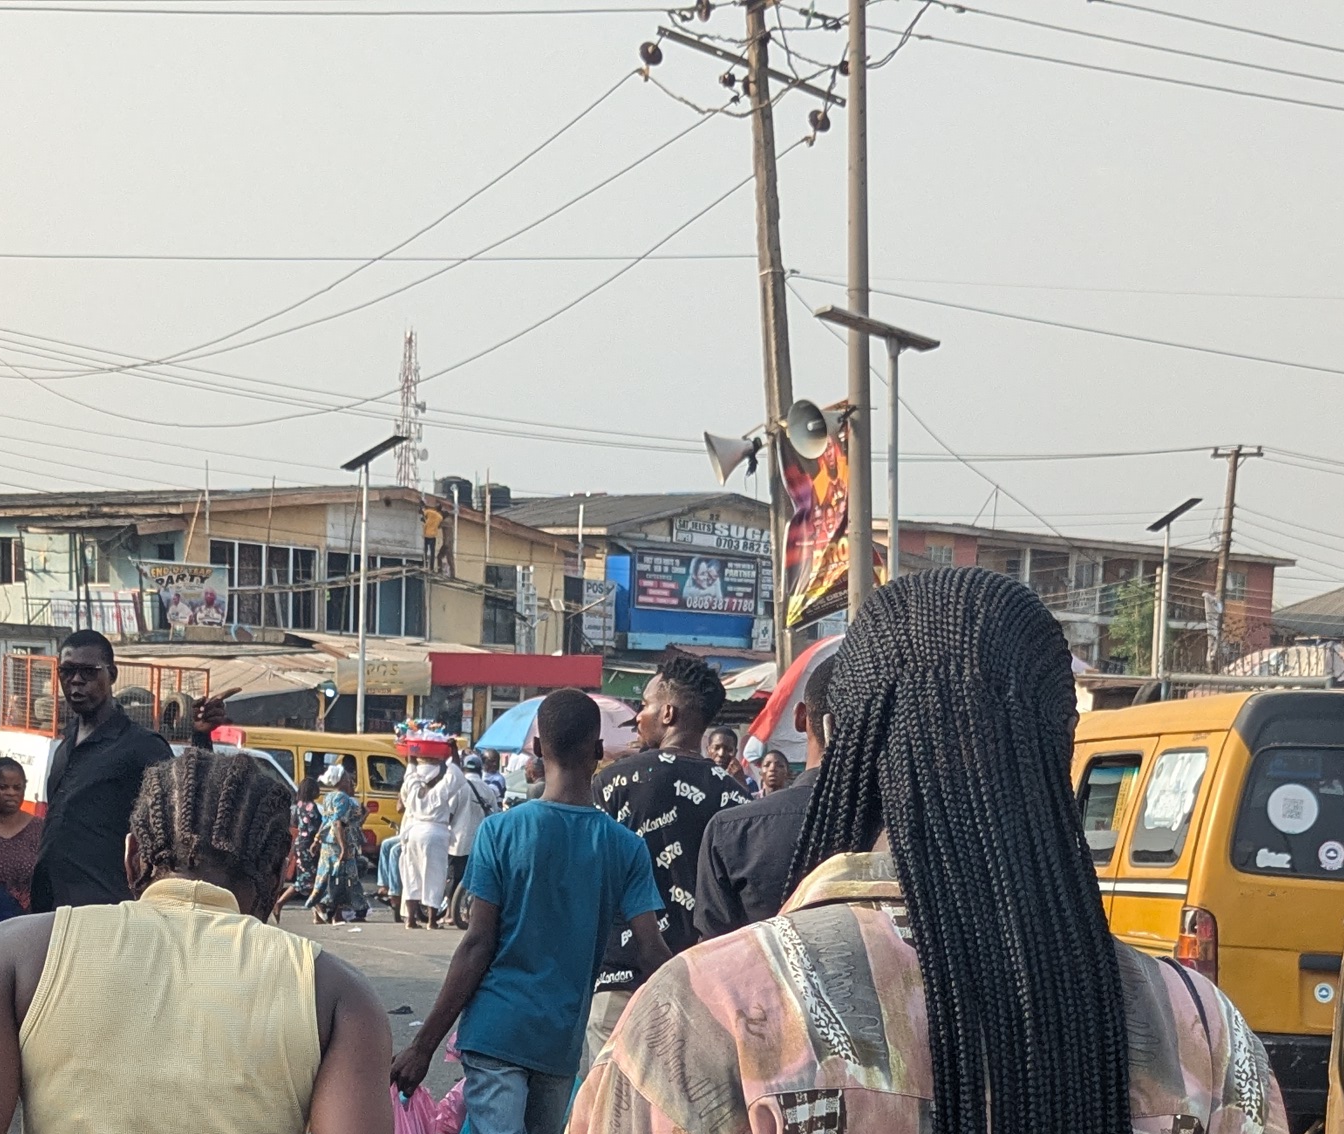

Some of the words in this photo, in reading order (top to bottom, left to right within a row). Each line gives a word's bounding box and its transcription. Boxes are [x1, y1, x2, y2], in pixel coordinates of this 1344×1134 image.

[691, 521, 712, 533] IELTS
[716, 537, 740, 551] 0703
[742, 540, 762, 553] 882
[155, 573, 210, 589] PARTY
[586, 582, 604, 595] POS
[686, 596, 710, 610] 0806
[673, 780, 706, 805] 1976
[655, 841, 683, 870] 1976
[668, 885, 696, 911] 1976
